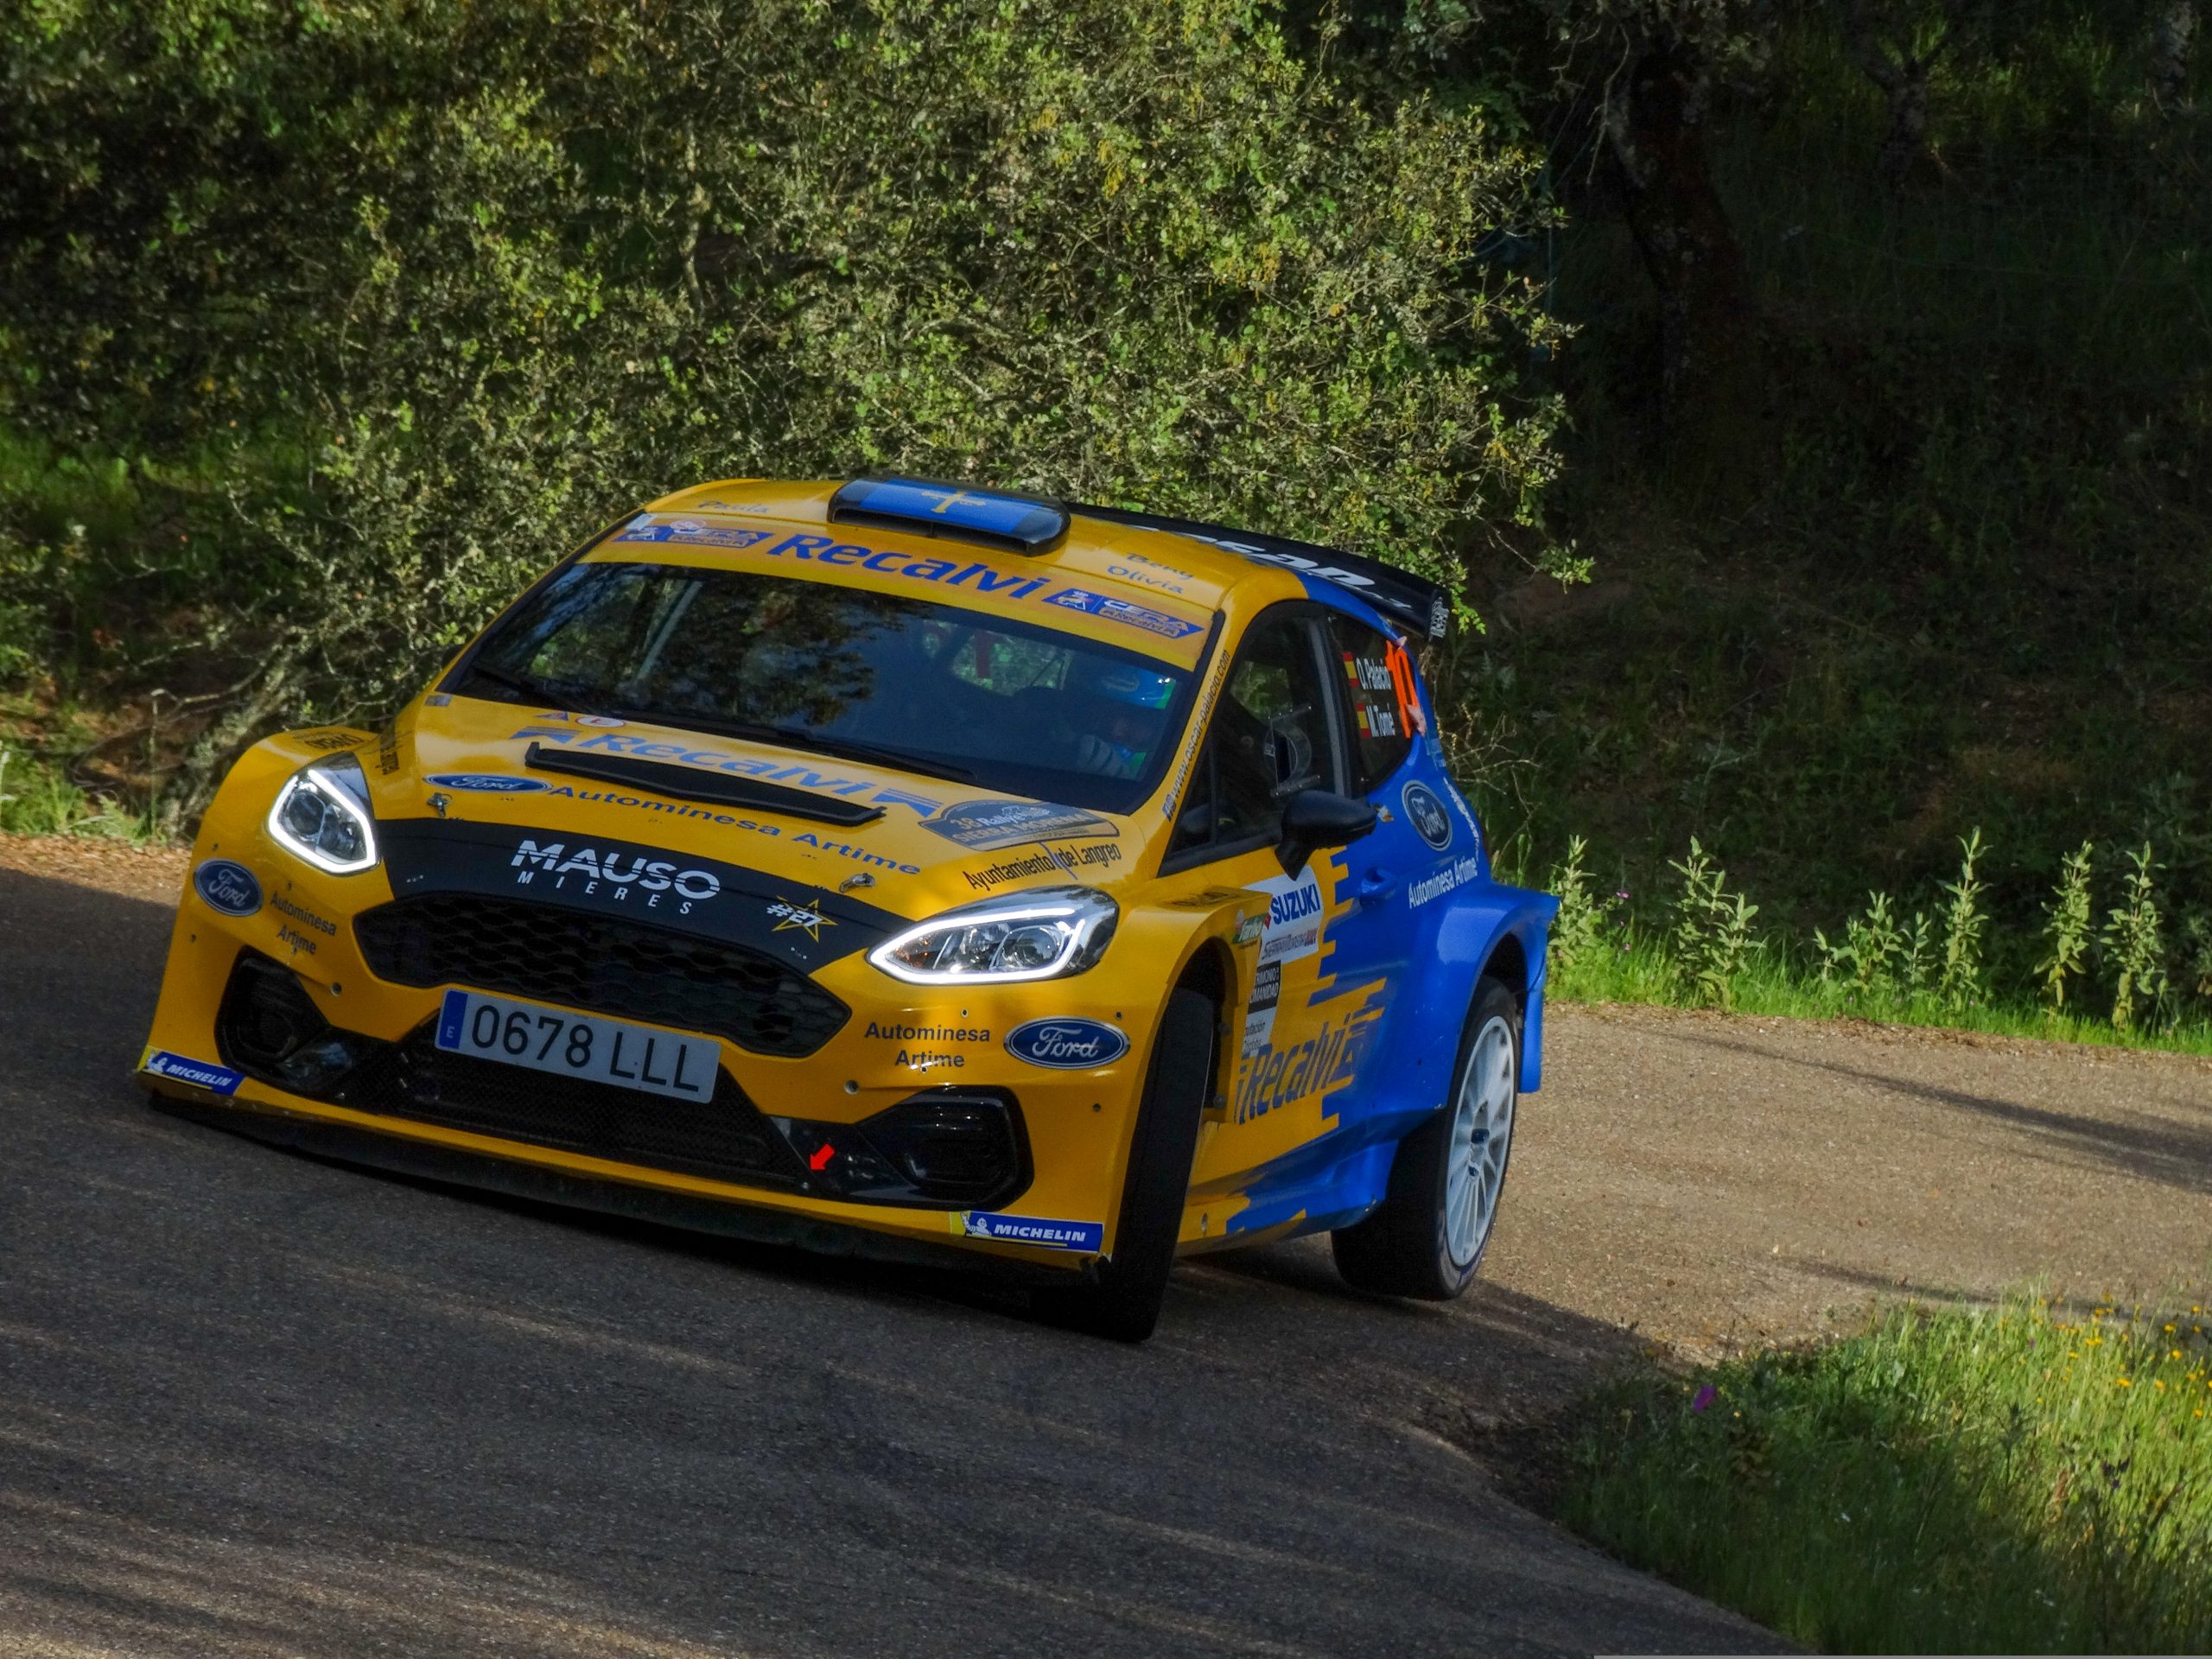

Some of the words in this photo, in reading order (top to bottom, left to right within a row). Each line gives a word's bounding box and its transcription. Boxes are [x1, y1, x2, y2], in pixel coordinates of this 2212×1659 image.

[767, 533, 1051, 600] Recalvi
[1107, 565, 1185, 594] Olivia
[1172, 649, 1230, 799] www.oscar-palacio.com
[451, 777, 524, 790] Ford
[578, 734, 874, 796] Recalvi
[547, 786, 781, 836] Autominesa
[791, 832, 921, 875] Artime
[952, 824, 1013, 843] SIERRA
[1412, 797, 1446, 838] Ford
[208, 868, 250, 906] Ford
[511, 840, 721, 899] MAUSO
[963, 853, 1058, 892] Ayuntamiento
[1058, 847, 1078, 868] de
[1071, 842, 1122, 868] Langreo
[1408, 868, 1455, 910] Autominesa
[1453, 855, 1478, 887] Artime
[517, 870, 692, 915] MIERES
[1270, 883, 1321, 925] SUZUKI
[270, 891, 337, 937] Autominesa
[766, 904, 823, 927] #27
[276, 925, 317, 955] Artime
[446, 1025, 455, 1039] E
[471, 1004, 594, 1068] 0678
[609, 1031, 699, 1093] LLL
[865, 1022, 990, 1043] Autominesa
[1032, 1026, 1099, 1058] Ford
[166, 1064, 233, 1087] MICHELIN
[894, 1050, 965, 1068] Artime
[1239, 1012, 1352, 1125] Recalvi
[994, 1224, 1087, 1243] MICHELIN
